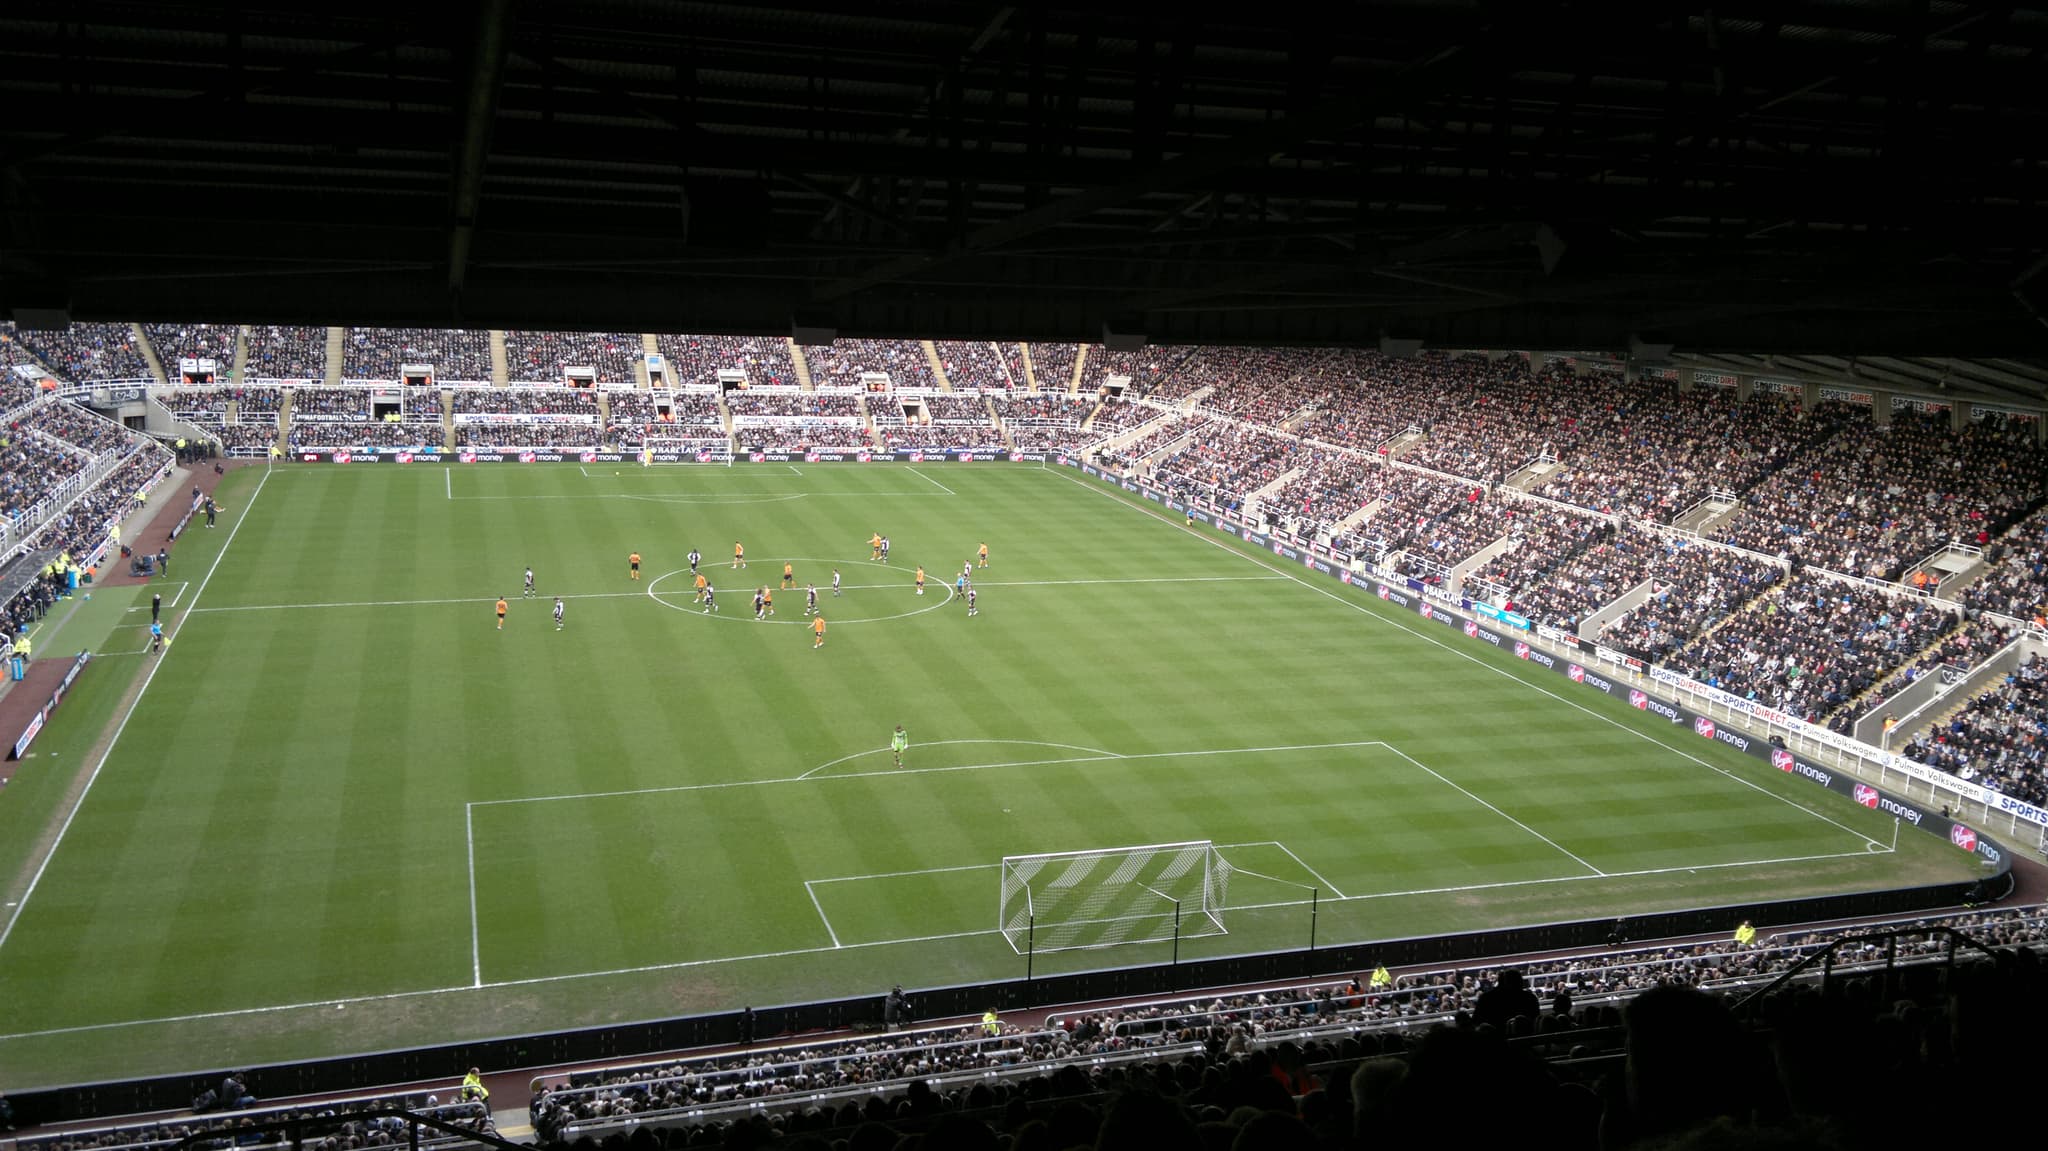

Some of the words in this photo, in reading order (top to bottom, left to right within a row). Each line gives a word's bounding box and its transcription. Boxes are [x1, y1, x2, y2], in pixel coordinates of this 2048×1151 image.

[1695, 372, 1738, 387] SPORTSDIRE
[1389, 592, 1408, 608] money
[1428, 585, 1464, 606] BARCLAYS
[1432, 609, 1453, 626] money
[1478, 628, 1501, 647] money
[1530, 650, 1554, 669] money
[1585, 673, 1612, 694] money
[1648, 699, 1678, 721] money
[1716, 729, 1749, 752] money
[1802, 723, 1830, 742] Pulman
[1832, 735, 1878, 762] Volkswagen
[1795, 761, 1832, 788] money
[1894, 757, 1924, 778] Pulman
[1928, 769, 1980, 800] Volkswagen
[1881, 796, 1922, 826] money
[2001, 797, 2048, 824] SPORTS
[1978, 840, 2001, 865] mon
